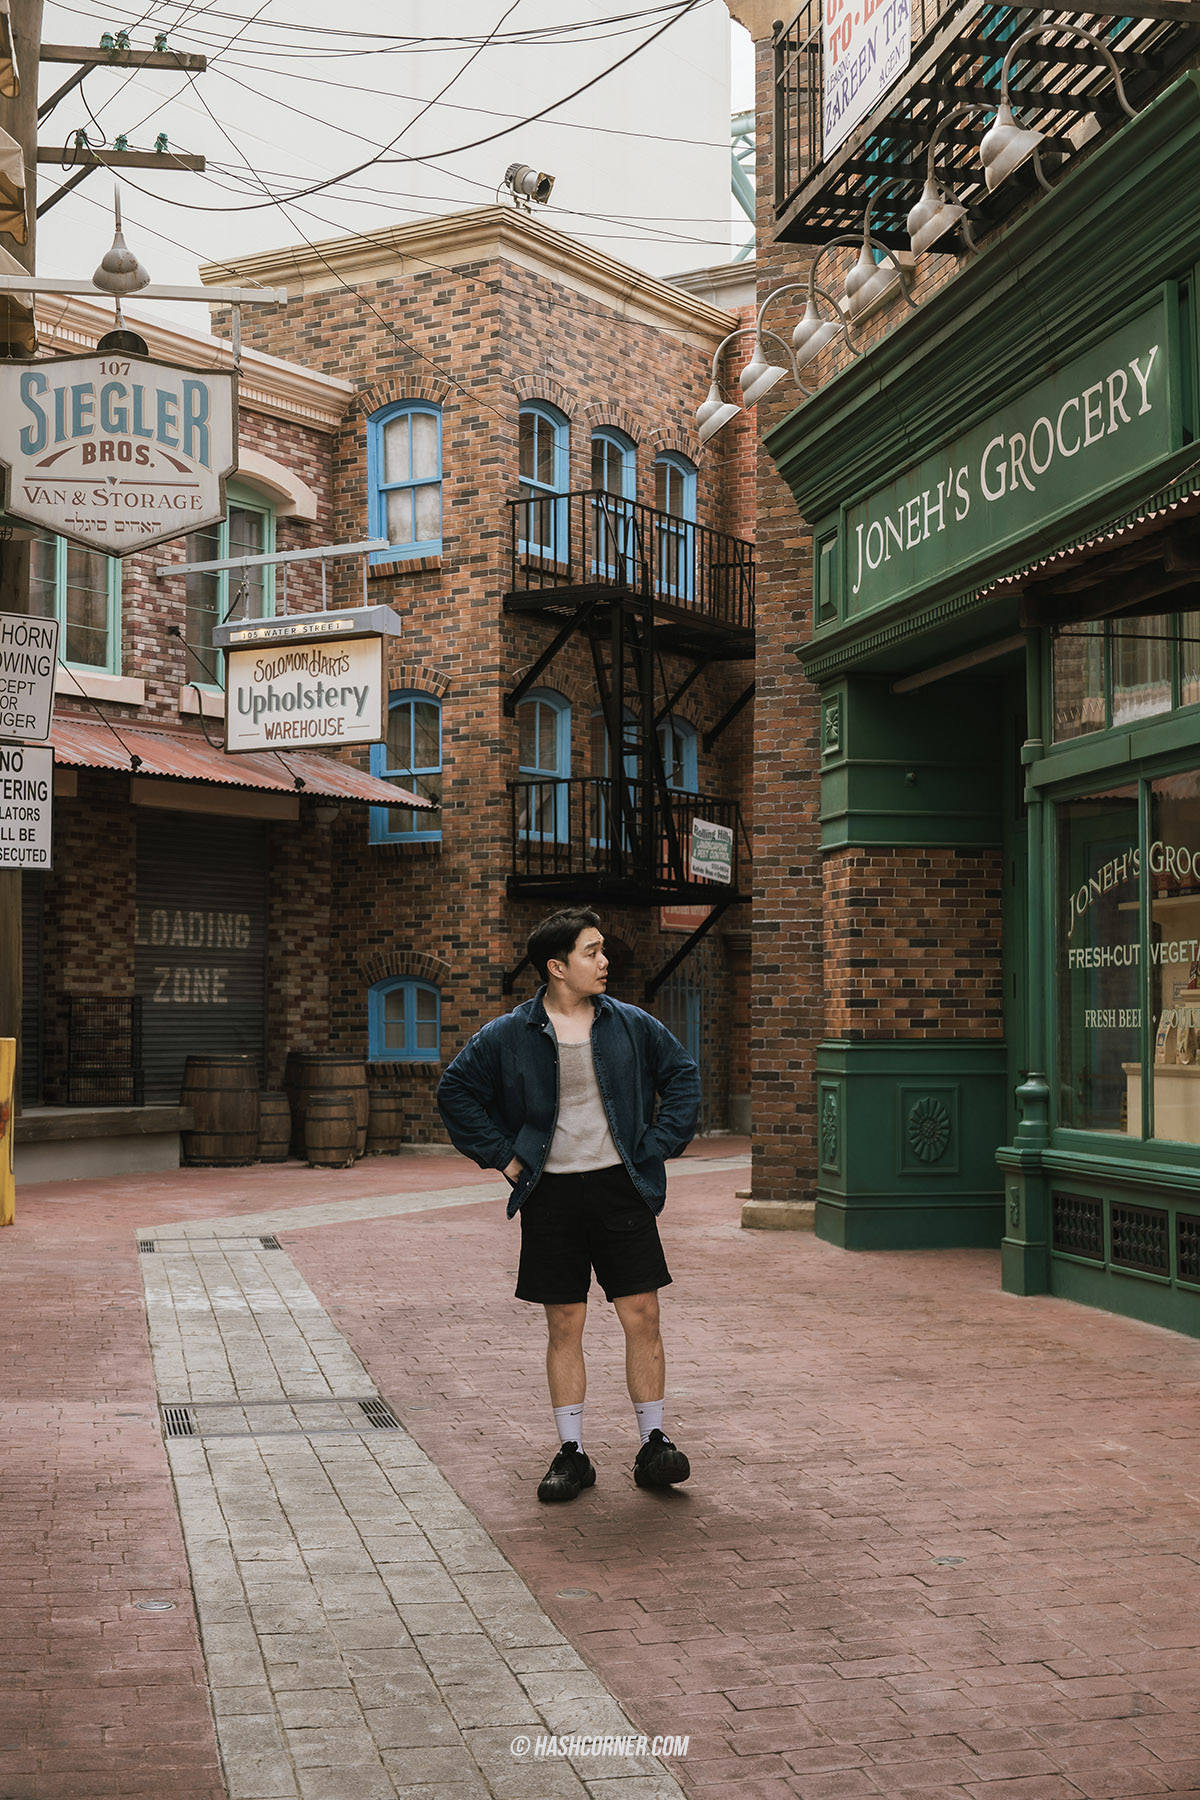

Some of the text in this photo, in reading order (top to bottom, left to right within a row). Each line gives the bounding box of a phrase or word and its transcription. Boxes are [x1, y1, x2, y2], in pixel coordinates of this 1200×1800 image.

[880, 33, 906, 88] AGENT
[825, 26, 878, 137] ZAREEN
[99, 361, 131, 376] 107
[19, 371, 212, 472] SIEGLER
[82, 440, 155, 468] BROS.
[852, 344, 1159, 594] JONEH'S GROCERY
[22, 486, 204, 510] VAN & STORAGE
[2, 623, 53, 649] HORN
[264, 627, 296, 637] WATER
[303, 622, 341, 633] STREET
[0, 651, 50, 677] WING
[254, 649, 350, 683] SOLOMON HART'S
[237, 681, 369, 725] Upholstery
[0, 712, 36, 729] GER
[264, 717, 345, 740] WAREHOUSE
[0, 751, 23, 773] NO
[19, 828, 36, 841] BE
[1068, 847, 1140, 938] JONEH'S
[134, 908, 250, 948] LOADING
[1068, 940, 1200, 969] FRESH-CUT VEGET
[153, 967, 229, 1003] ZONE
[1085, 1009, 1116, 1028] FRESH
